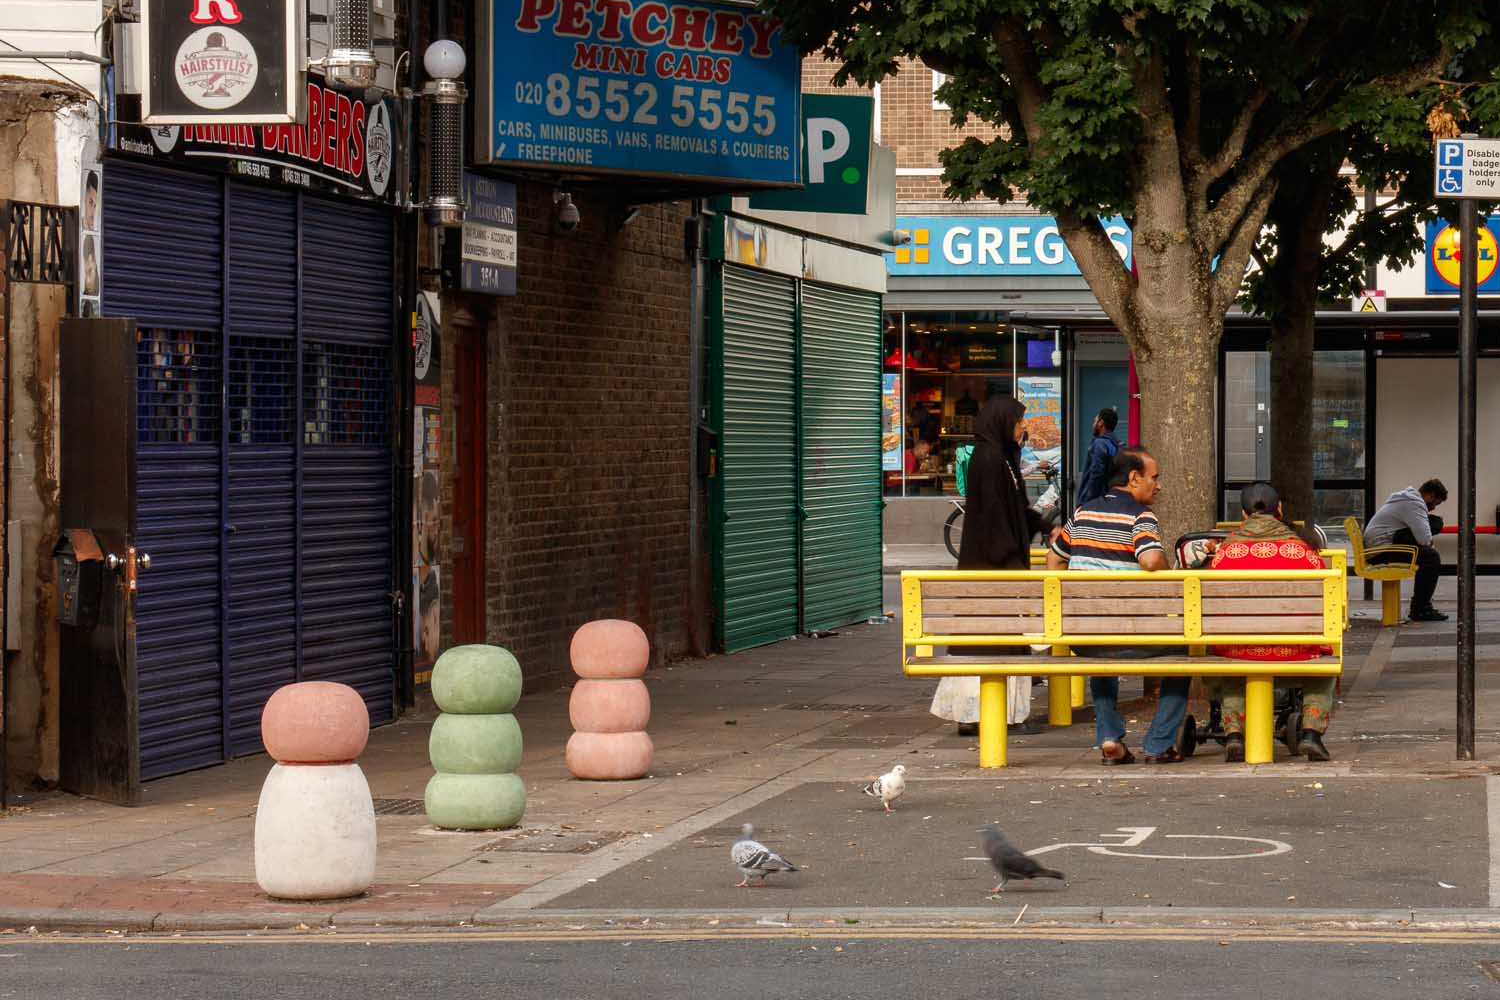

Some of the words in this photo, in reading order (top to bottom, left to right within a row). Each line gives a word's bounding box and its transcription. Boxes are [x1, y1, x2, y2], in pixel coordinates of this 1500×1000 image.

[180, 58, 253, 77] HAIRSTYLIST
[572, 42, 648, 75] MINI
[655, 51, 731, 85] CABS
[515, 81, 543, 105] 020
[545, 73, 657, 125] 8552
[671, 85, 776, 137] 5555
[498, 120, 536, 142] CARS,
[540, 124, 612, 149] MINIBUSES,
[616, 130, 651, 151] VANS,
[656, 134, 718, 155] REMOVALS
[721, 140, 729, 156] &
[733, 141, 789, 161] COURIERS
[518, 143, 593, 165] FREEPHONE
[1445, 144, 1460, 165] P
[1472, 160, 1500, 168] badge
[1476, 178, 1495, 187] only
[942, 226, 1128, 265] GREGS
